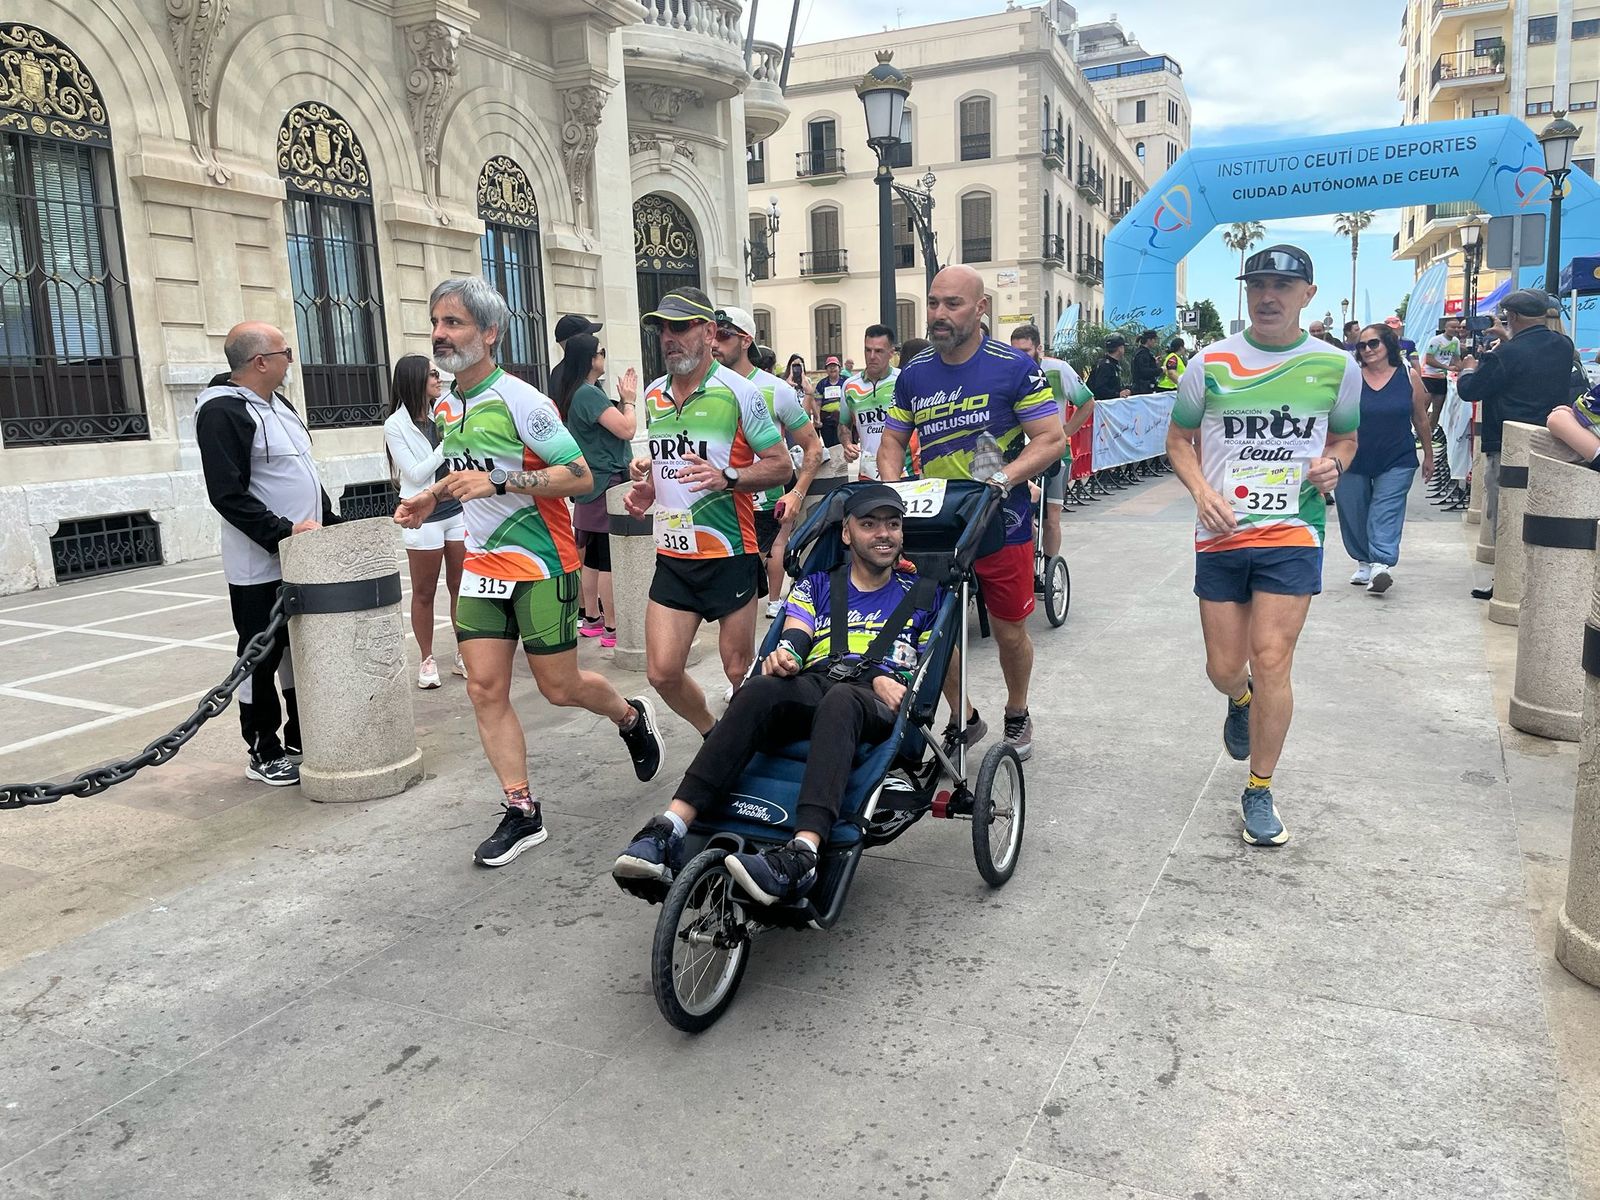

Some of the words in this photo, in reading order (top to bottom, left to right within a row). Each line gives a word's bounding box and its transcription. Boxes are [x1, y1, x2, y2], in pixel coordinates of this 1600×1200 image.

[1217, 156, 1300, 178] INSTITUTO
[1304, 147, 1353, 169] CEUTÍ
[1357, 147, 1380, 163] DE
[1385, 136, 1477, 160] DEPORTES
[1232, 185, 1288, 200] CIUDAD
[1291, 175, 1379, 195] AUTÓNOMA
[1383, 172, 1404, 185] DE
[1408, 166, 1460, 182] CEUTA
[866, 425, 885, 434] Ceut
[923, 410, 990, 436] INCLUSIÓN
[1239, 445, 1294, 461] Ceuta
[1247, 492, 1288, 510] 325
[663, 533, 689, 551] 318
[477, 577, 508, 595] 315
[731, 800, 769, 813] Advance
[736, 807, 771, 821] Mobility
